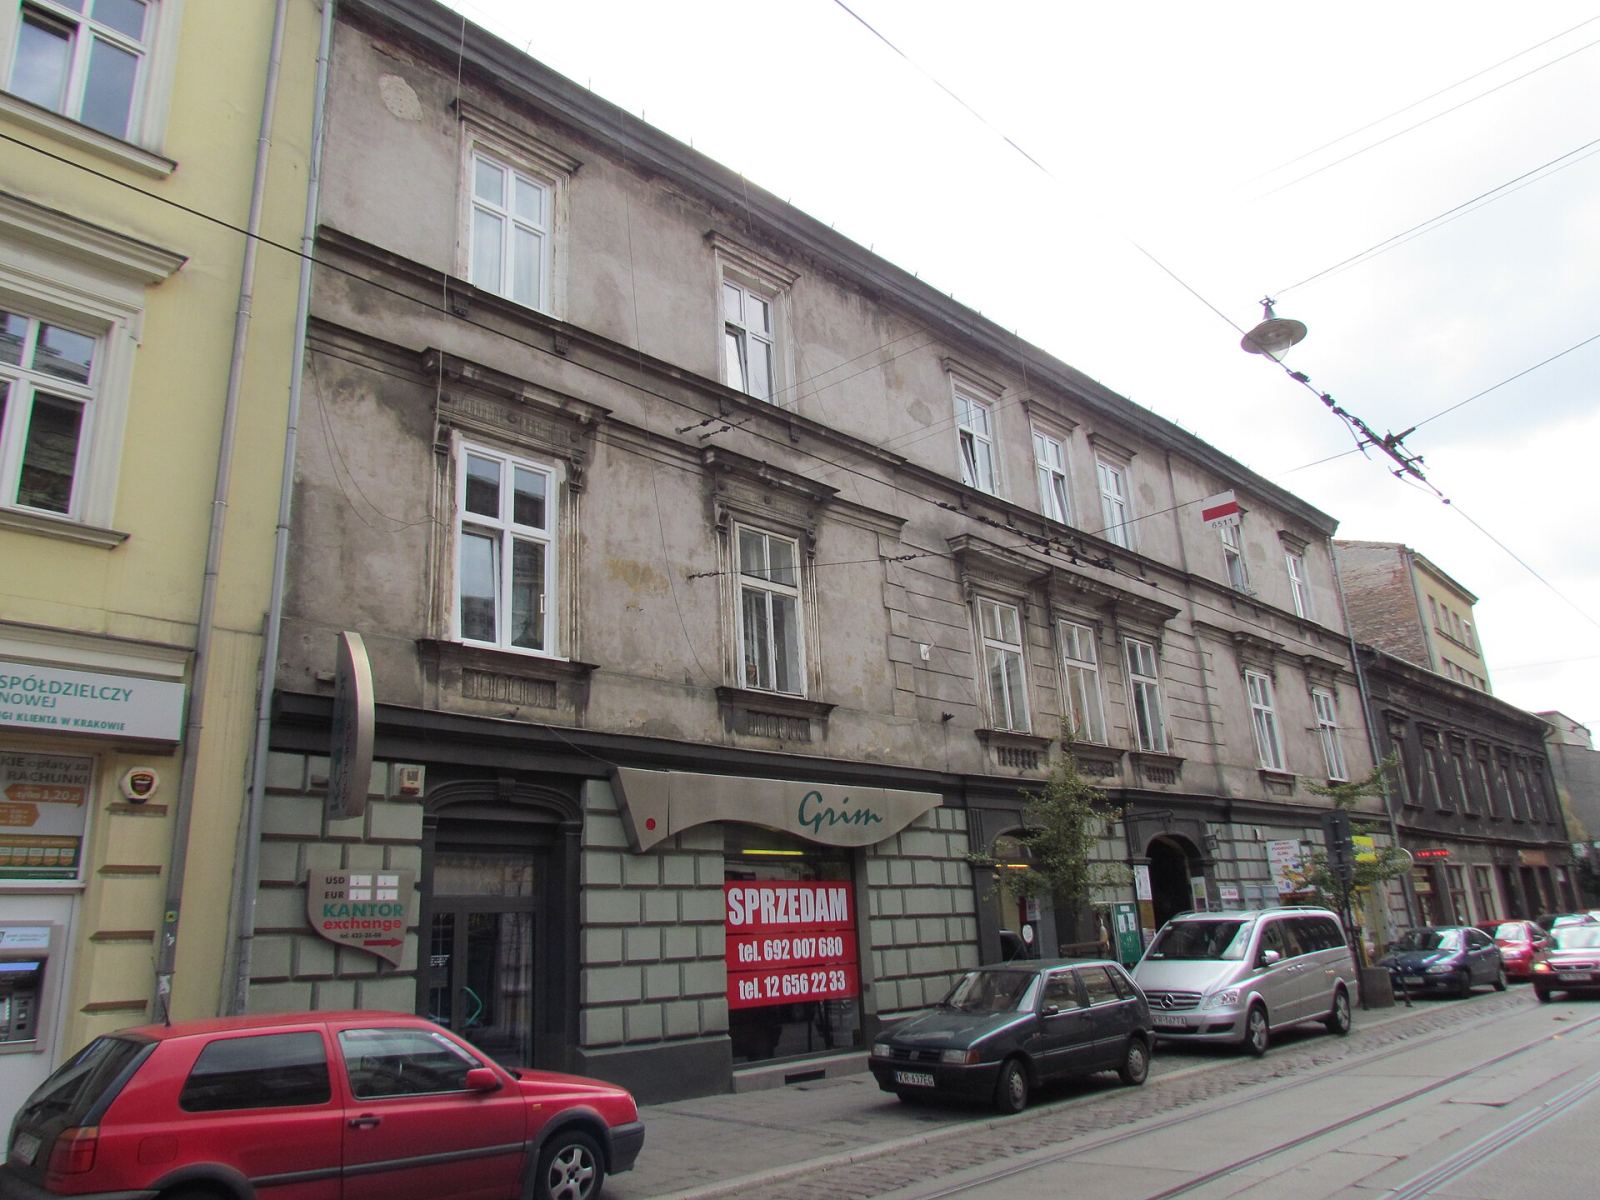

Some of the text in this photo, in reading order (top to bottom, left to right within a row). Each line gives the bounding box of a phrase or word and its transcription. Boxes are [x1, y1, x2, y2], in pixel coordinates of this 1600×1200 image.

[0, 674, 133, 702] SPÓŁDZIELCZY
[0, 691, 57, 708] NOWEJ
[16, 713, 57, 725] KLIENTA
[60, 717, 71, 727] W
[73, 718, 126, 731] KRAKOWIE
[798, 790, 883, 834] Grim
[325, 876, 345, 885] USD
[324, 891, 345, 900] EUR
[323, 902, 404, 918] KANTOR
[727, 887, 848, 926] SPRZEDAM
[323, 917, 401, 931] exchange
[738, 936, 843, 963] tel. 692 007 680
[738, 970, 846, 1000] tel. 12 656 22 33
